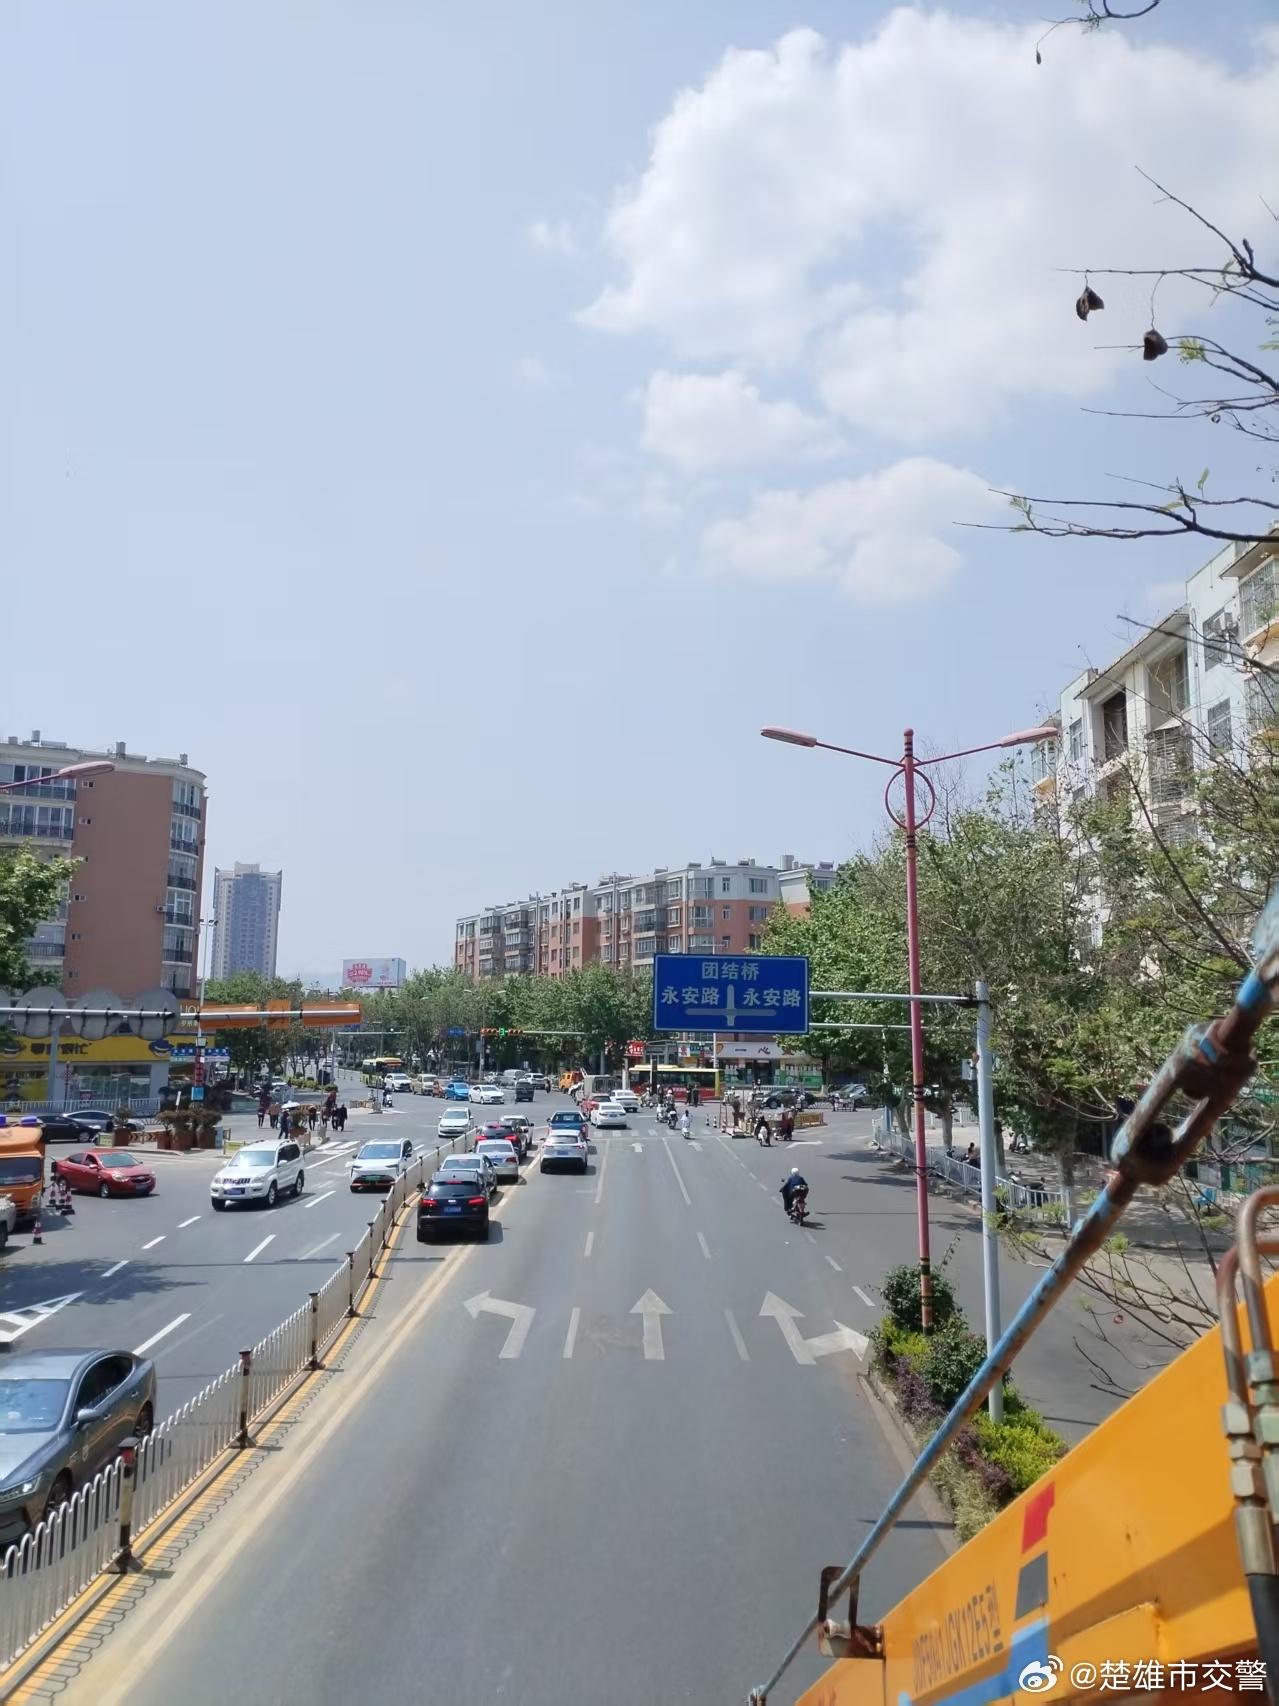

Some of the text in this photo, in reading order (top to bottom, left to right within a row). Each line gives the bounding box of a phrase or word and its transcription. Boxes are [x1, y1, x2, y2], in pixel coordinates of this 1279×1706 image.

[702, 961, 760, 981] 团结桥
[661, 985, 720, 1005] 永安路
[743, 987, 801, 1007] 永安路
